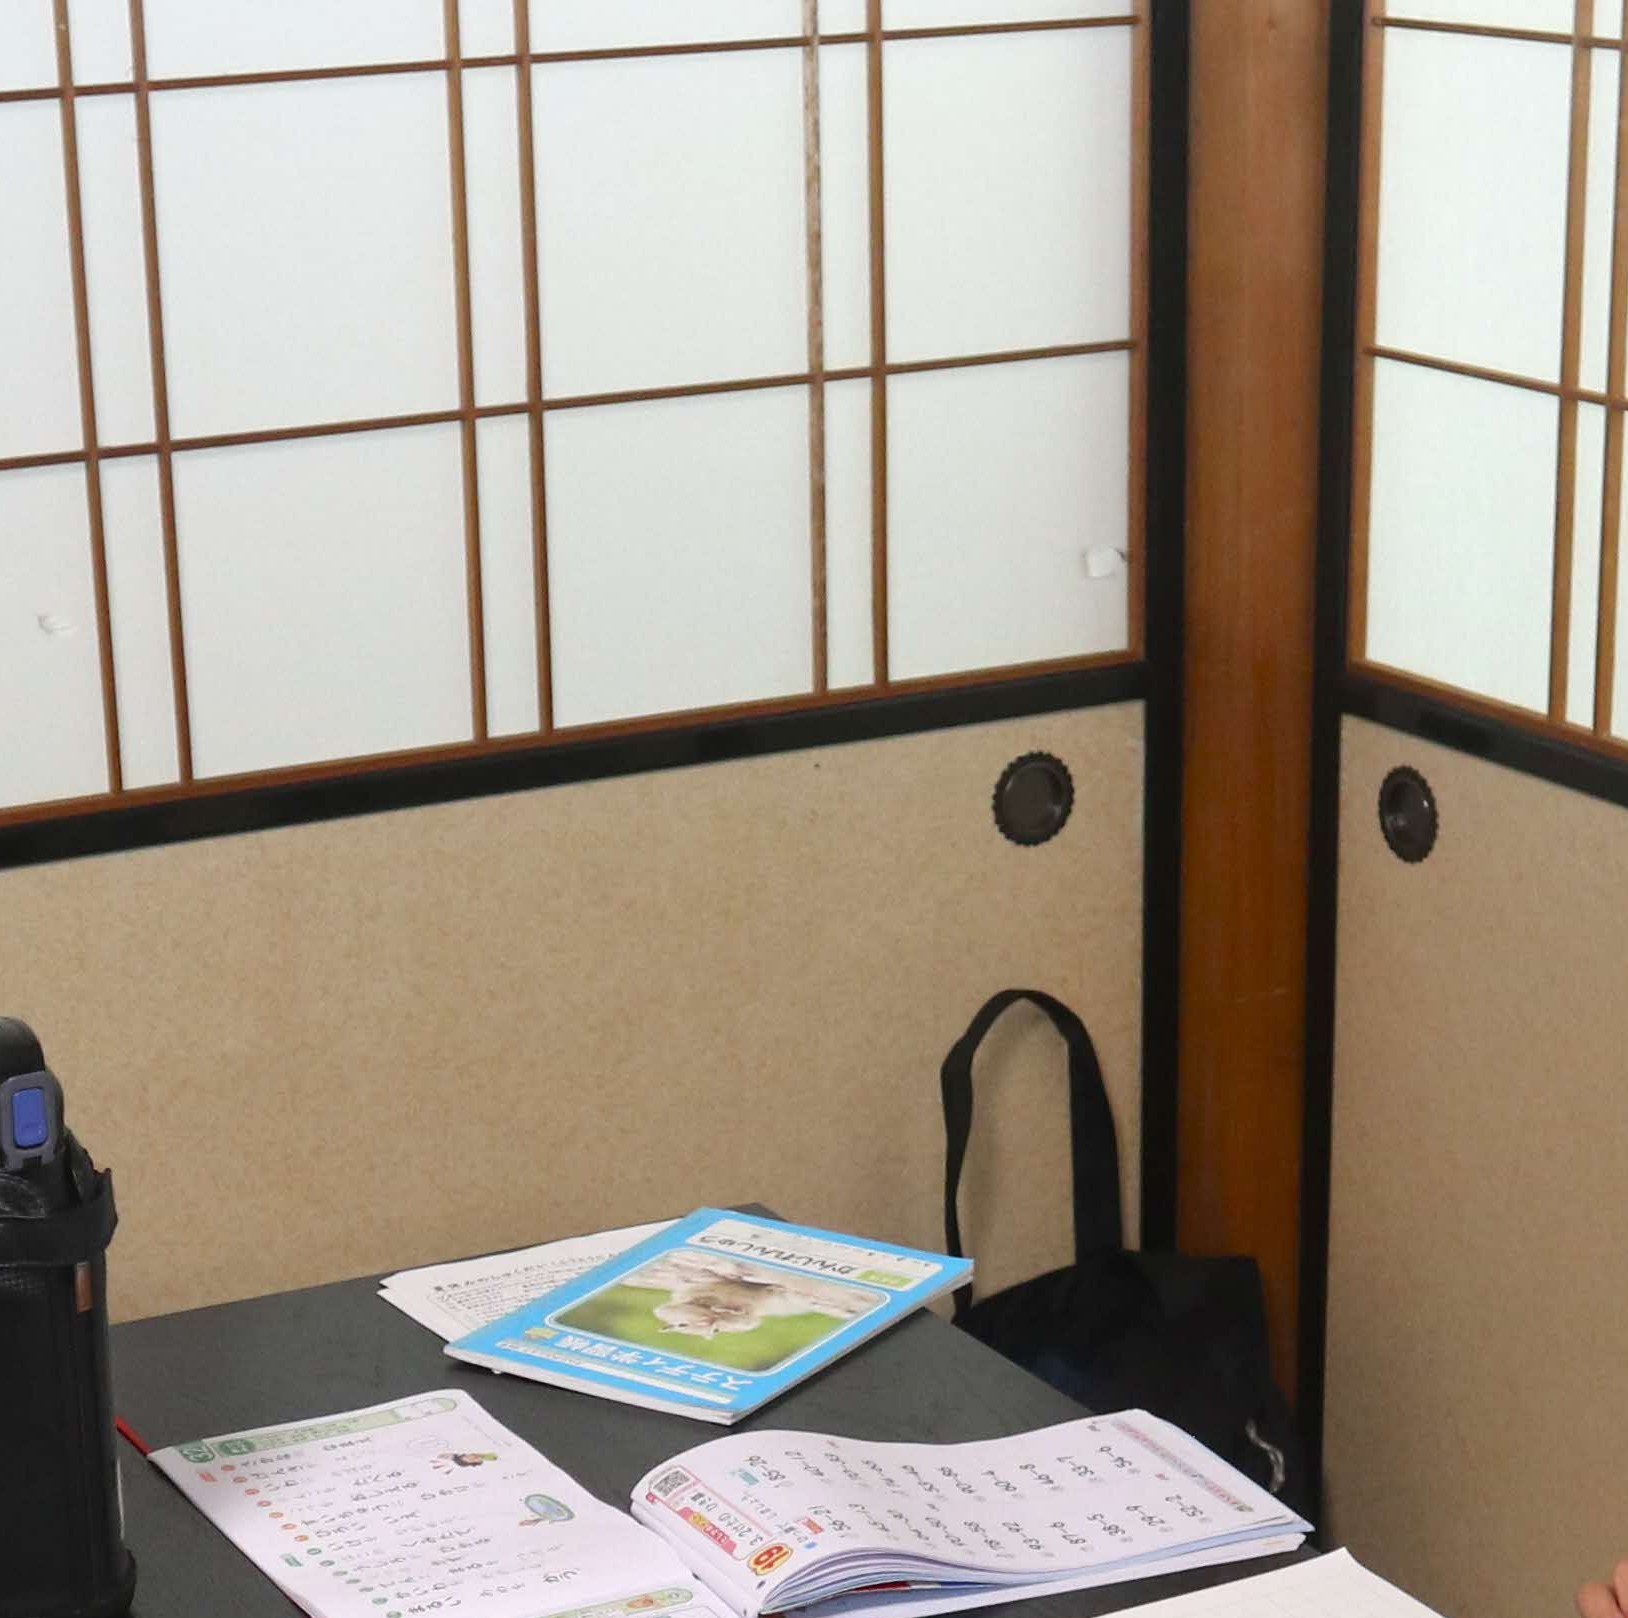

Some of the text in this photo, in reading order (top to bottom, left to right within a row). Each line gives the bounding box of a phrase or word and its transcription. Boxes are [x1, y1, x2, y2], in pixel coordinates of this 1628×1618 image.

[554, 1335, 751, 1390] ステディ学習帳
[748, 1542, 794, 1572] 19
